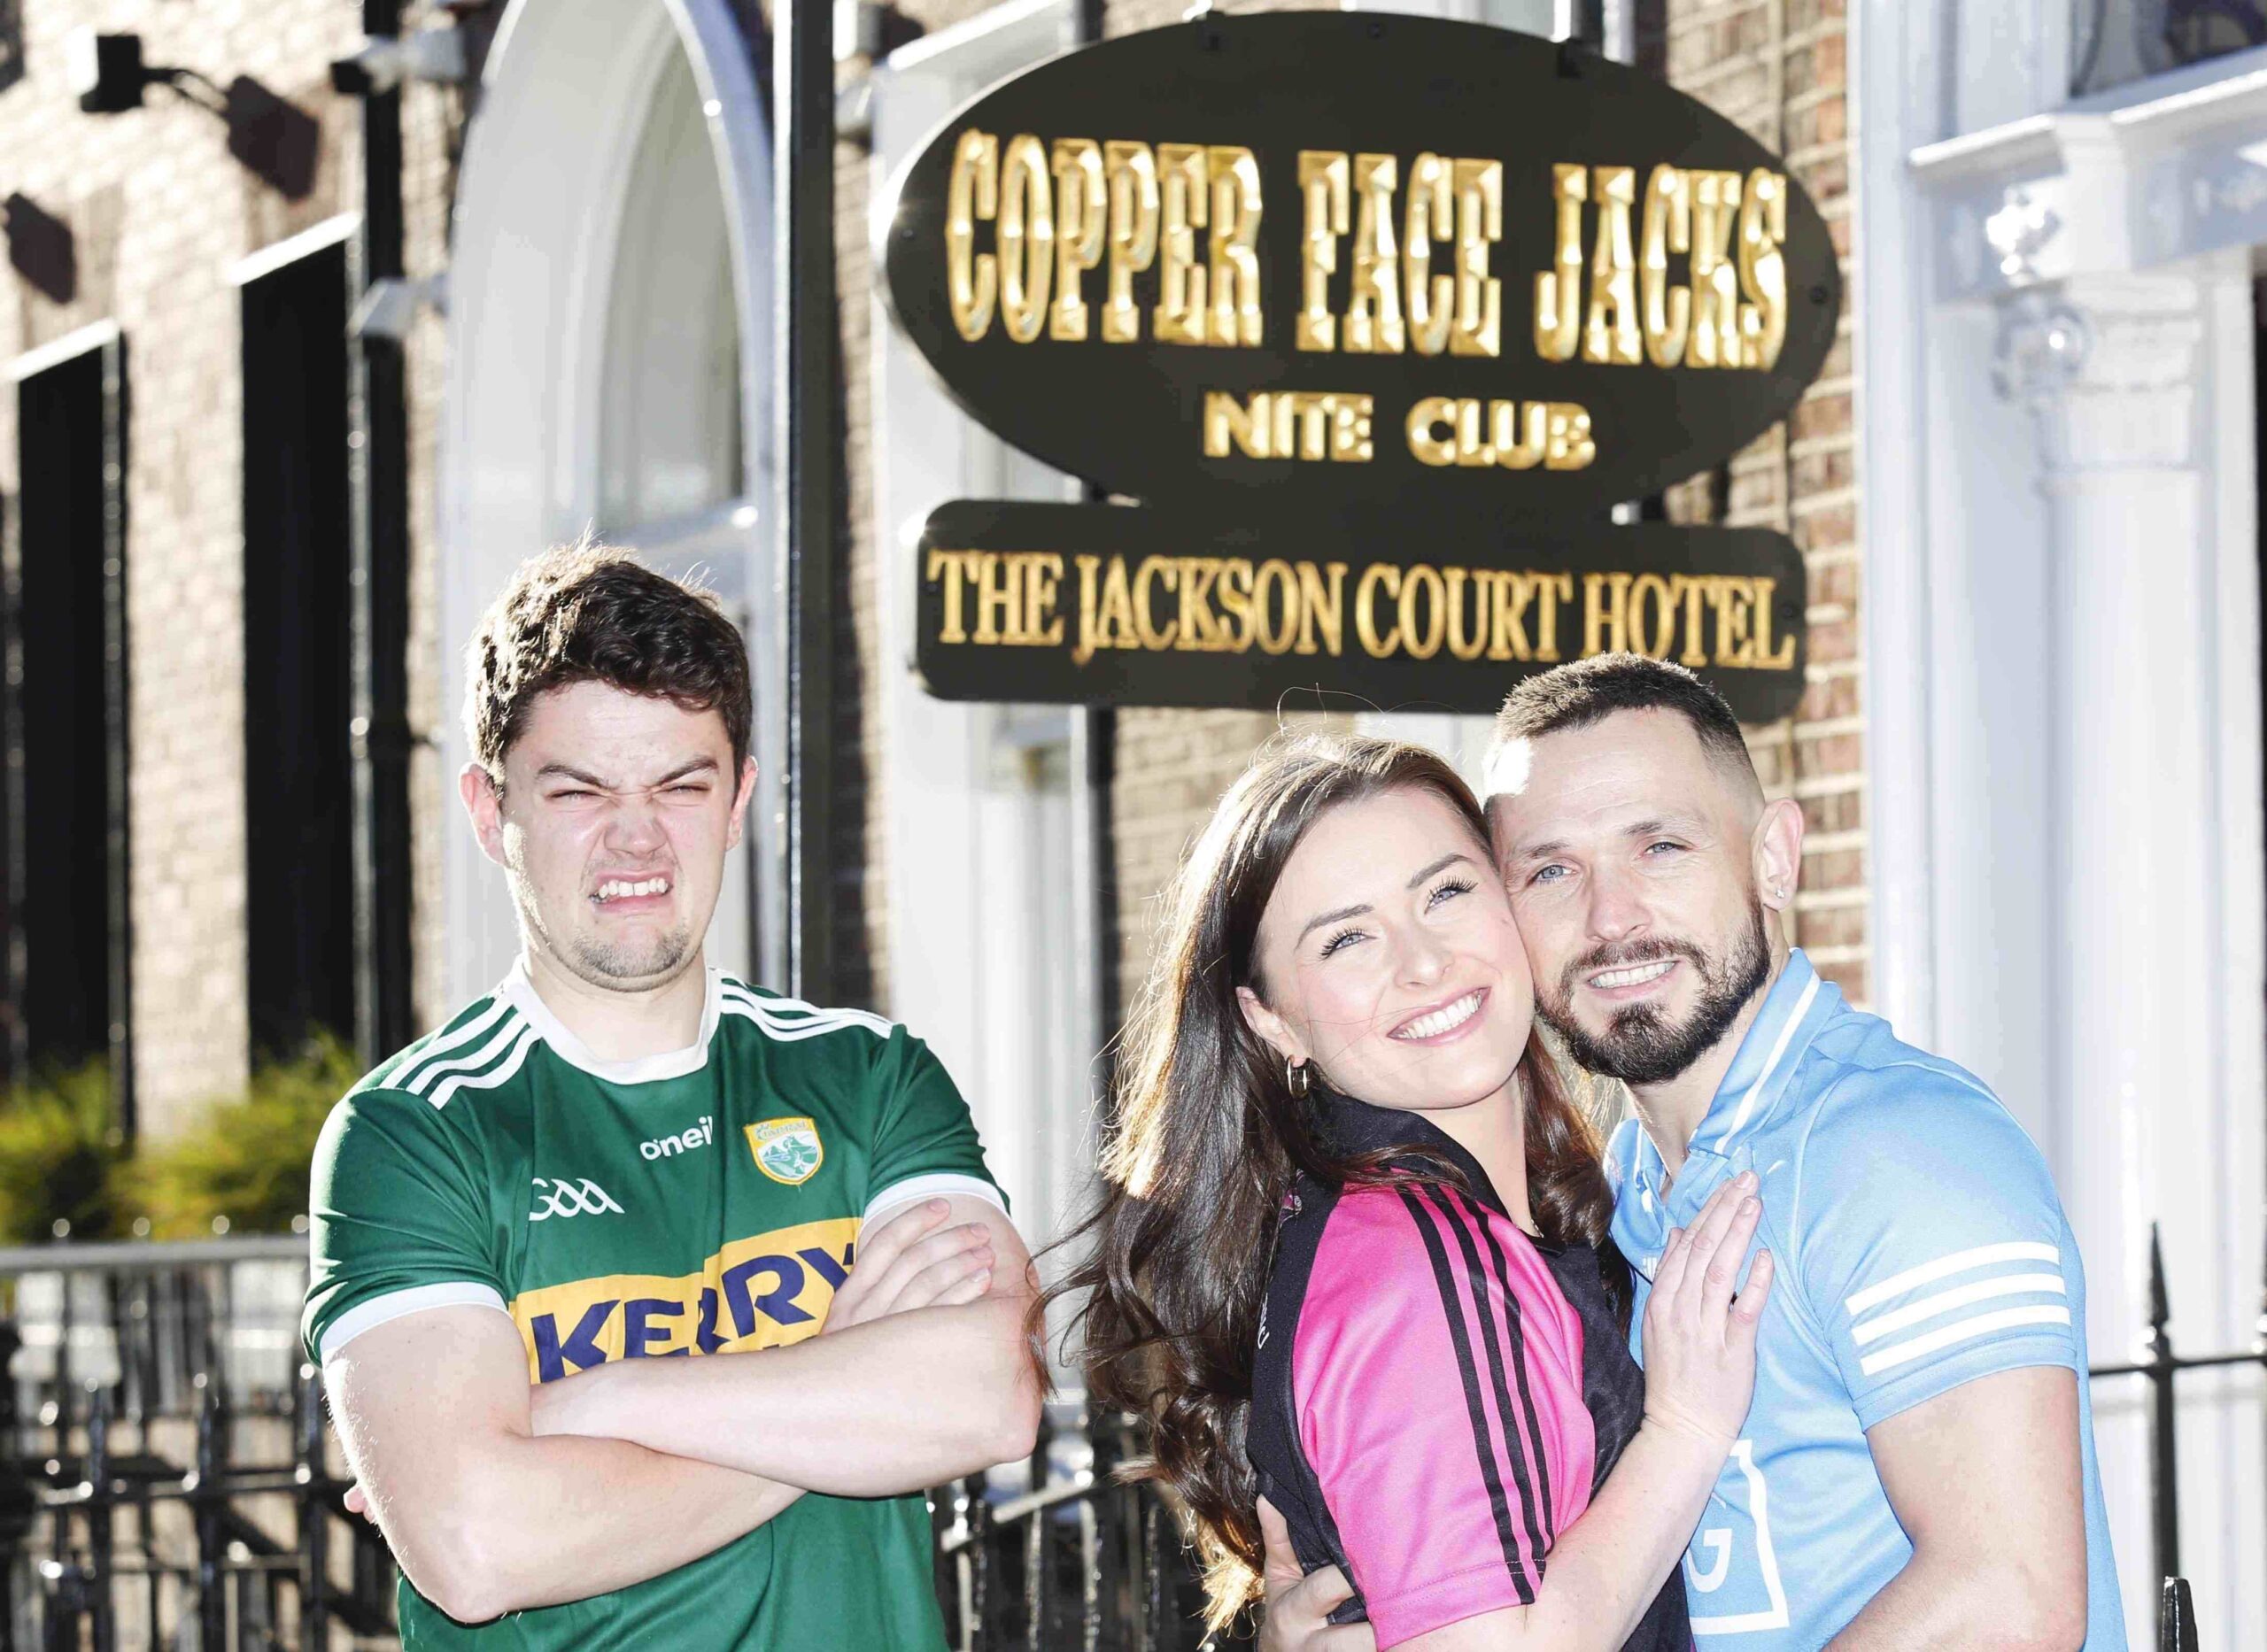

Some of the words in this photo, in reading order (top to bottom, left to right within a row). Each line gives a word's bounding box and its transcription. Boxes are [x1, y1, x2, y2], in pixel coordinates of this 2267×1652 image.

[945, 128, 1264, 347] COPPER
[1296, 149, 1504, 358] FACE
[1534, 162, 1788, 372] JACKS
[1203, 391, 1373, 462] NITE
[1405, 397, 1596, 470] CLUB
[926, 549, 1064, 647] THE
[1072, 554, 1350, 665] JACKSON
[1355, 563, 1574, 662] COURT
[1581, 572, 1796, 670] HOTEL
